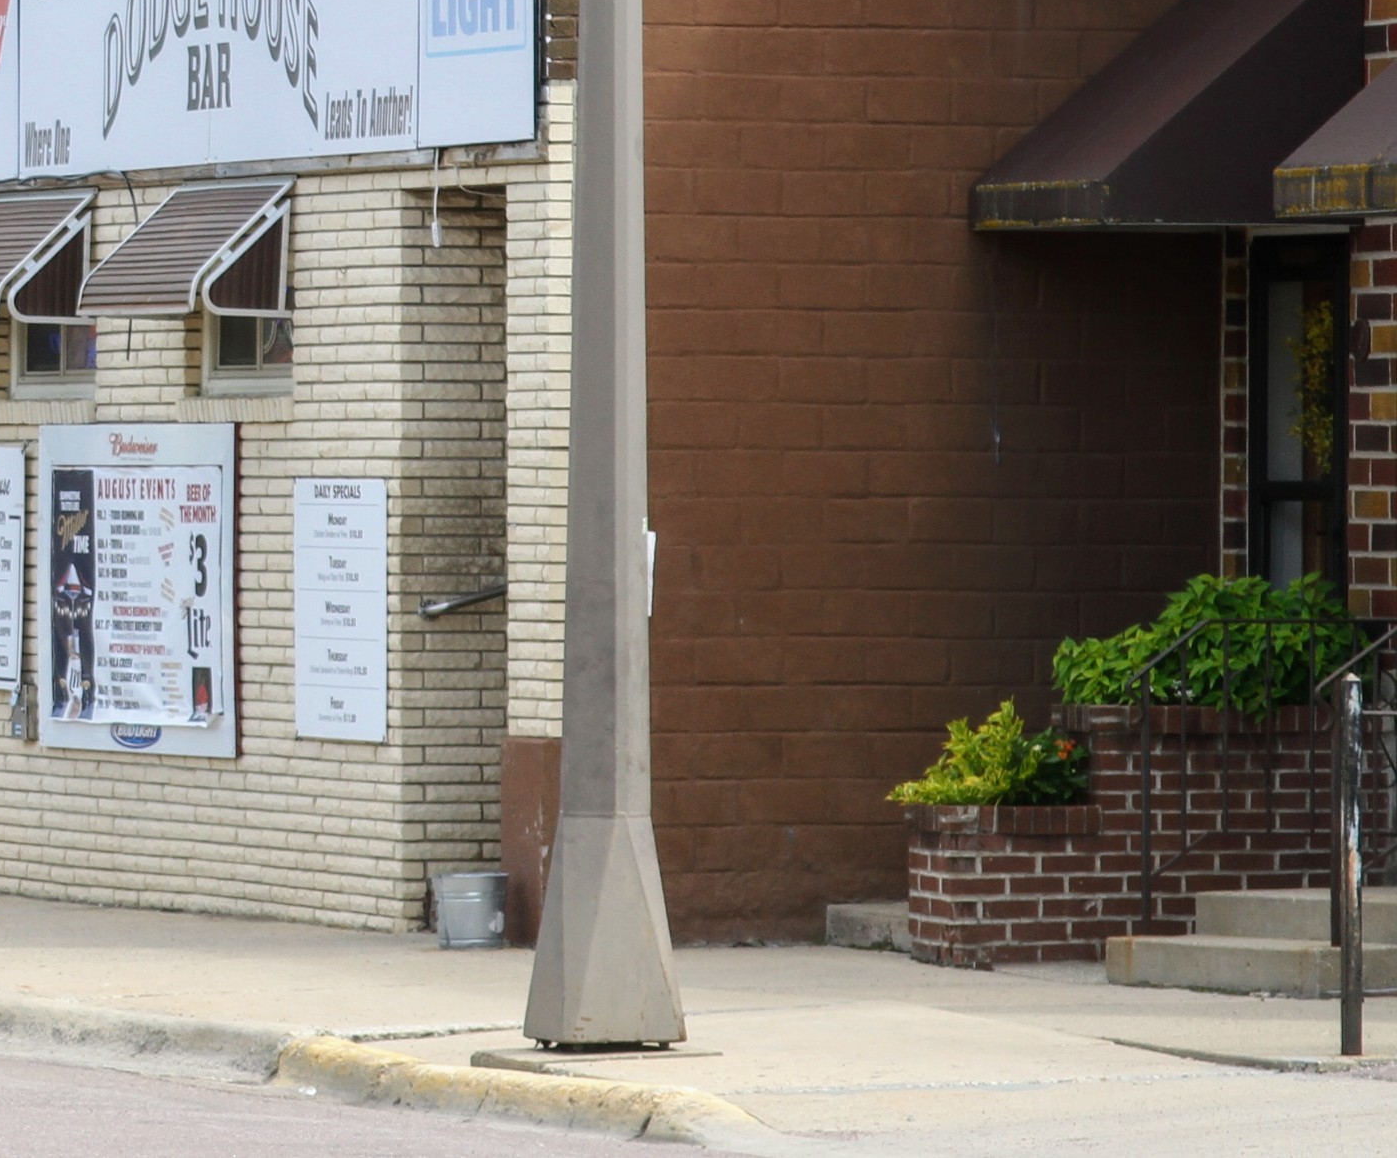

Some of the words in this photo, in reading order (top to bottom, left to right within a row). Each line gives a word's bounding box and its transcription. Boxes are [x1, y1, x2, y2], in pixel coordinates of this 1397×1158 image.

[186, 42, 232, 112] BAR
[324, 91, 353, 141] Leads
[356, 89, 368, 139] To
[369, 85, 414, 138] Another!
[24, 121, 53, 168] Where
[53, 119, 71, 166] One
[109, 432, 159, 457] Budweiser
[98, 478, 137, 500] AUGUST
[140, 477, 176, 500] EVENTS
[186, 484, 201, 502] BEER
[202, 483, 212, 502] OF
[314, 485, 331, 499] DAILY
[333, 485, 361, 499] SPECIALS
[179, 505, 194, 523] THE
[193, 505, 217, 524] MONTH
[57, 509, 89, 551] Miller
[73, 534, 90, 554] TIME
[189, 530, 208, 597] $3
[187, 606, 211, 660] Lite
[117, 723, 134, 737] BUD
[134, 724, 157, 738] LIGHT
